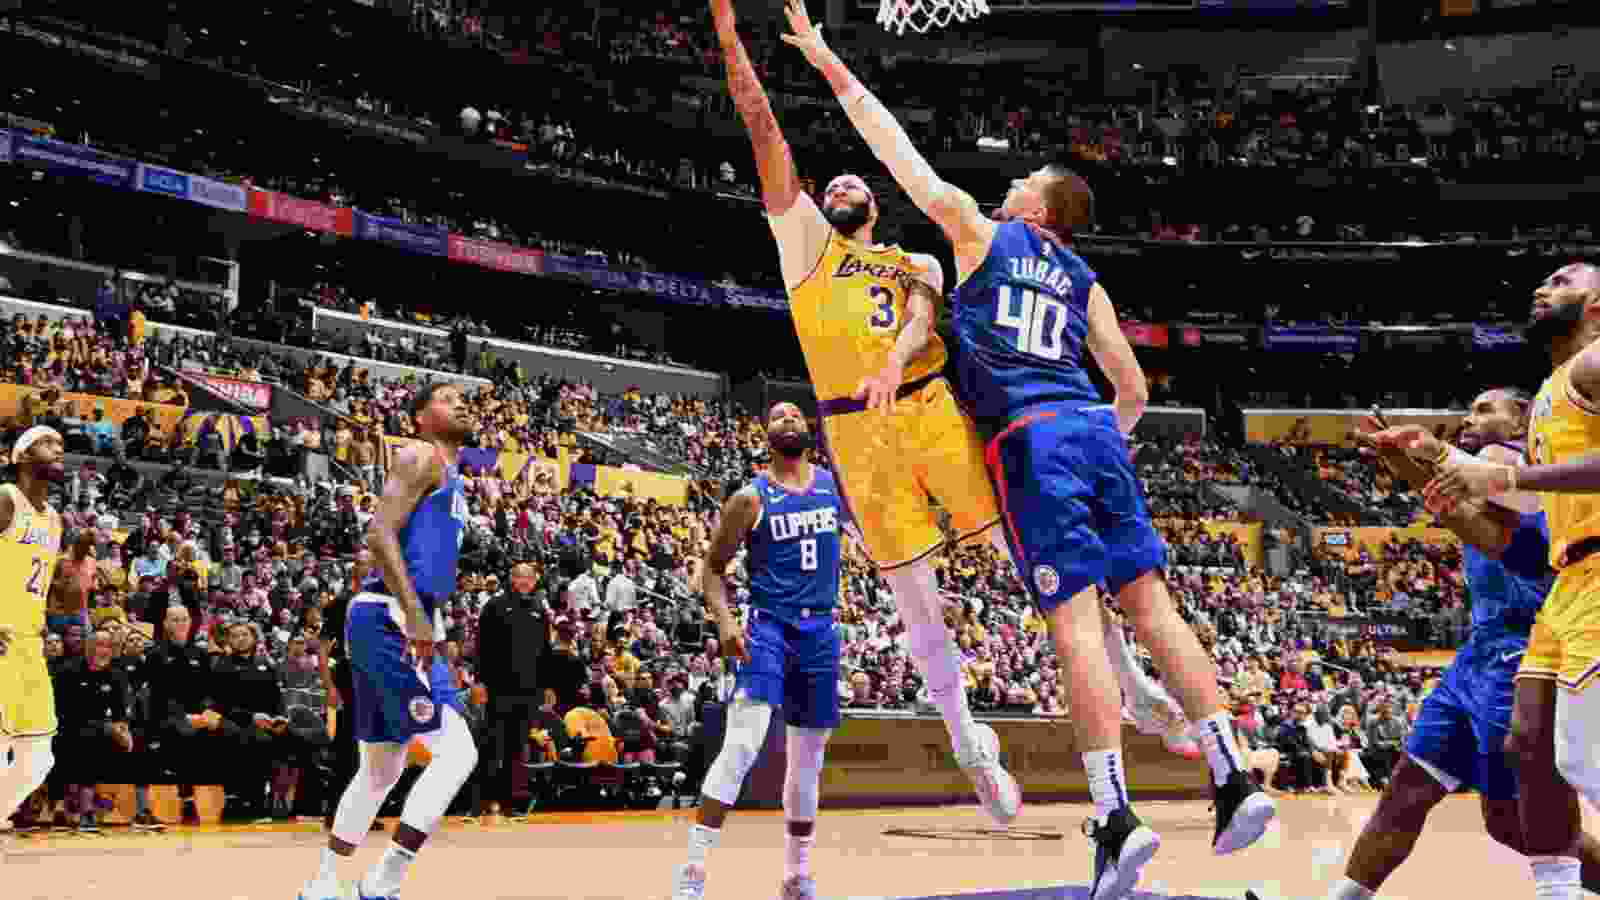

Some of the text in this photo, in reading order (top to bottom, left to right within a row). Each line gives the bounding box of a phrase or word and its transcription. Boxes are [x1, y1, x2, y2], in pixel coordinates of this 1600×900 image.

[653, 279, 710, 304] DELTA
[869, 285, 895, 328] 3
[992, 285, 1067, 361] 40
[769, 507, 837, 541] CLIPPERS
[800, 539, 817, 572] 8
[26, 558, 48, 598] 21
